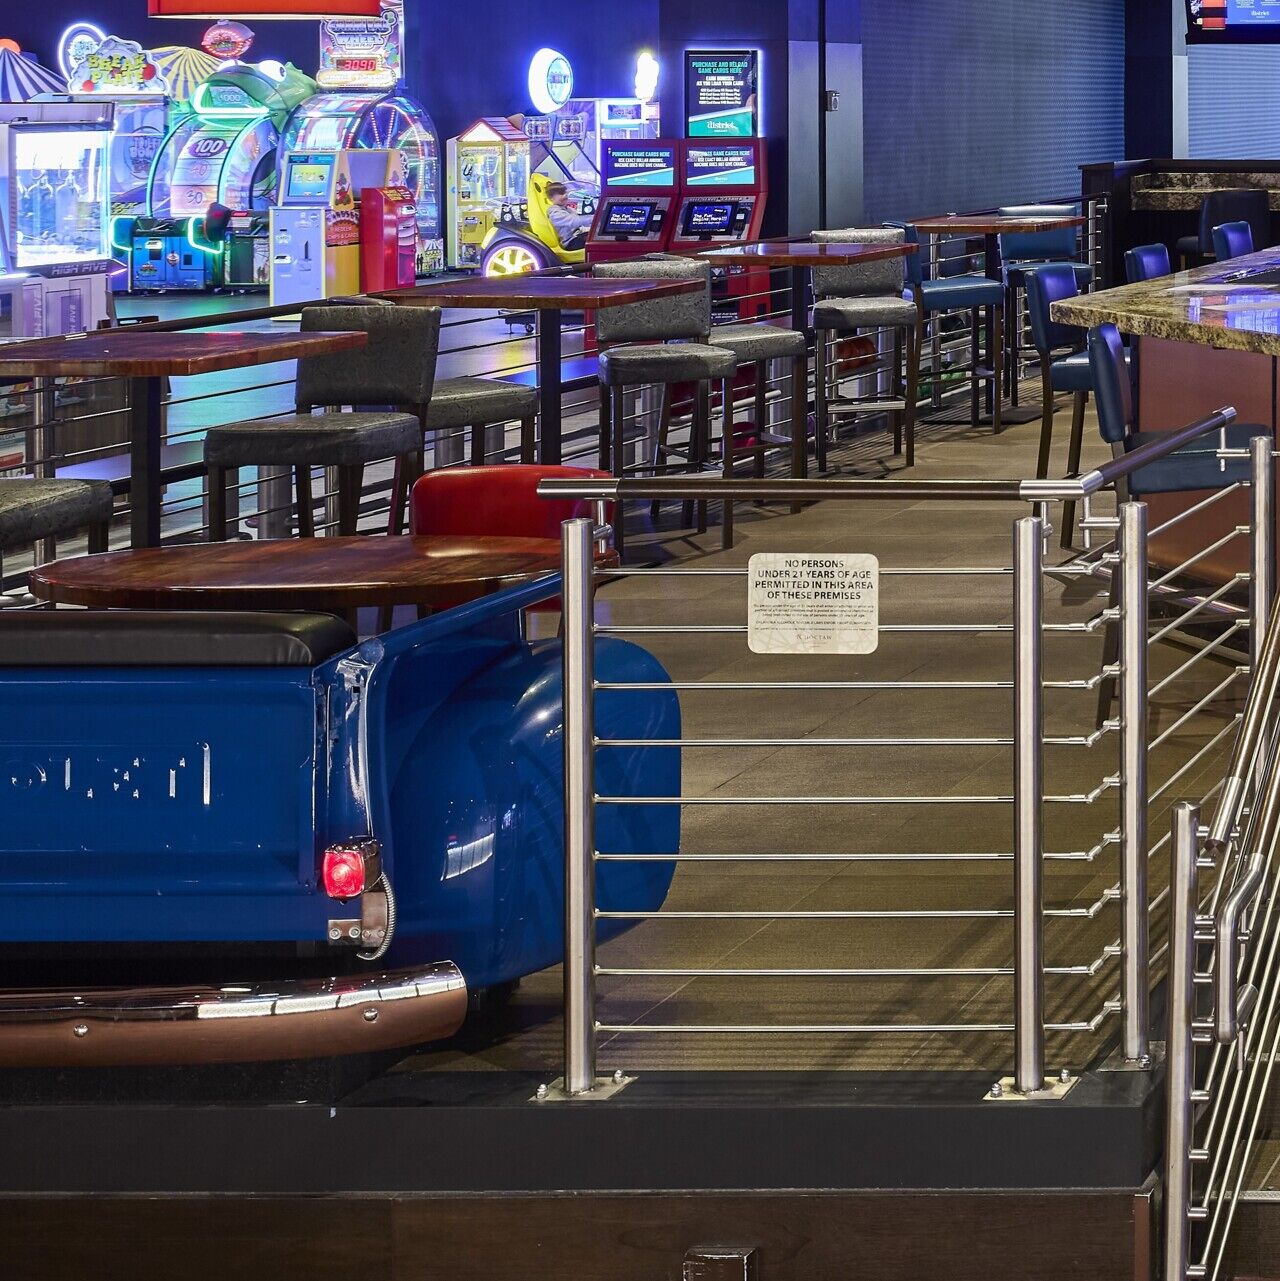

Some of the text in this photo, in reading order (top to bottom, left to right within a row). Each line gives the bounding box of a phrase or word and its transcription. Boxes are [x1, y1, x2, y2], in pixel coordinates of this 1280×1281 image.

[344, 59, 377, 70] 3090
[51, 262, 107, 275] HIGH FIVE
[785, 560, 844, 568] NO PERSONS
[758, 570, 790, 578] UNDER
[755, 581, 873, 589] PERMITTED IN THIS AREA
[767, 591, 779, 599] OF
[782, 591, 812, 599] THESE
